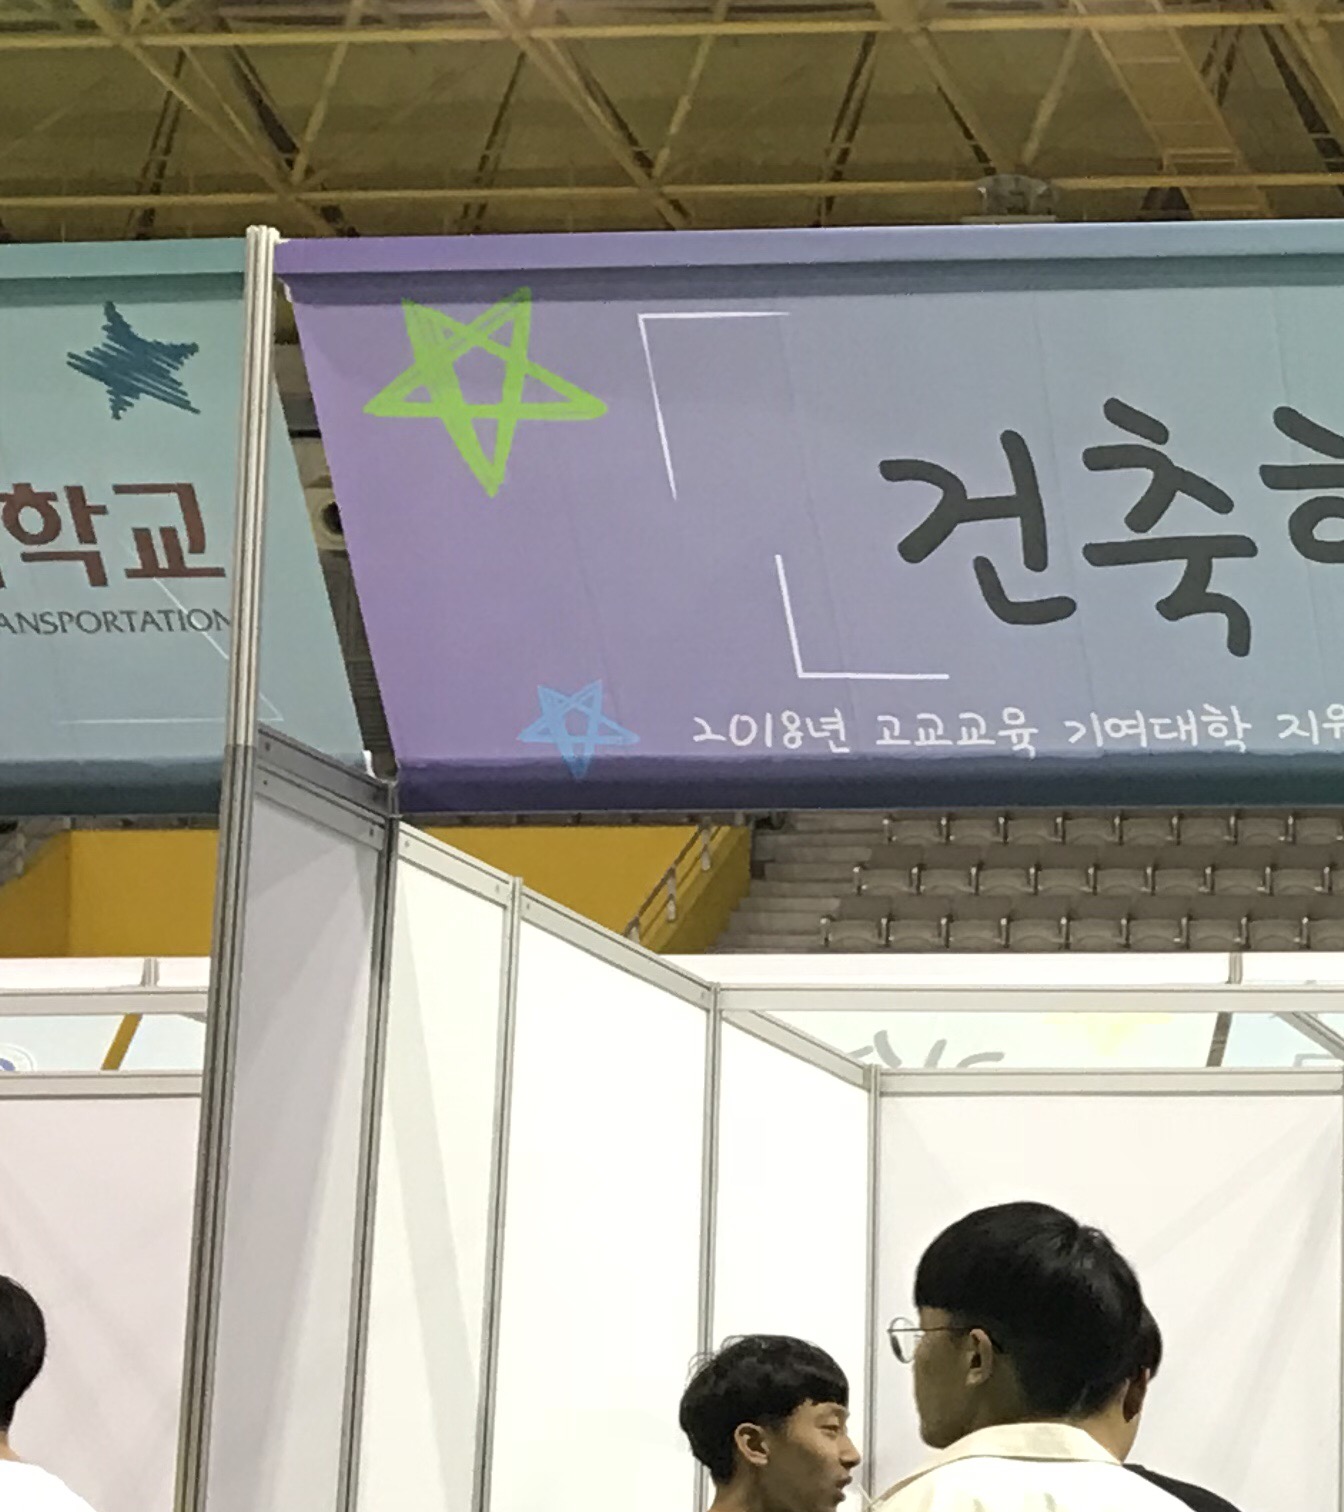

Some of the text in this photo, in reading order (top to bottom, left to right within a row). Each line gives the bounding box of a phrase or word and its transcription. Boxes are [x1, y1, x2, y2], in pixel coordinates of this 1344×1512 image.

[0, 482, 227, 588] 학교
[692, 706, 850, 754] 2018년
[876, 706, 1039, 759] 고교교육
[1064, 703, 1252, 754] 기여대학
